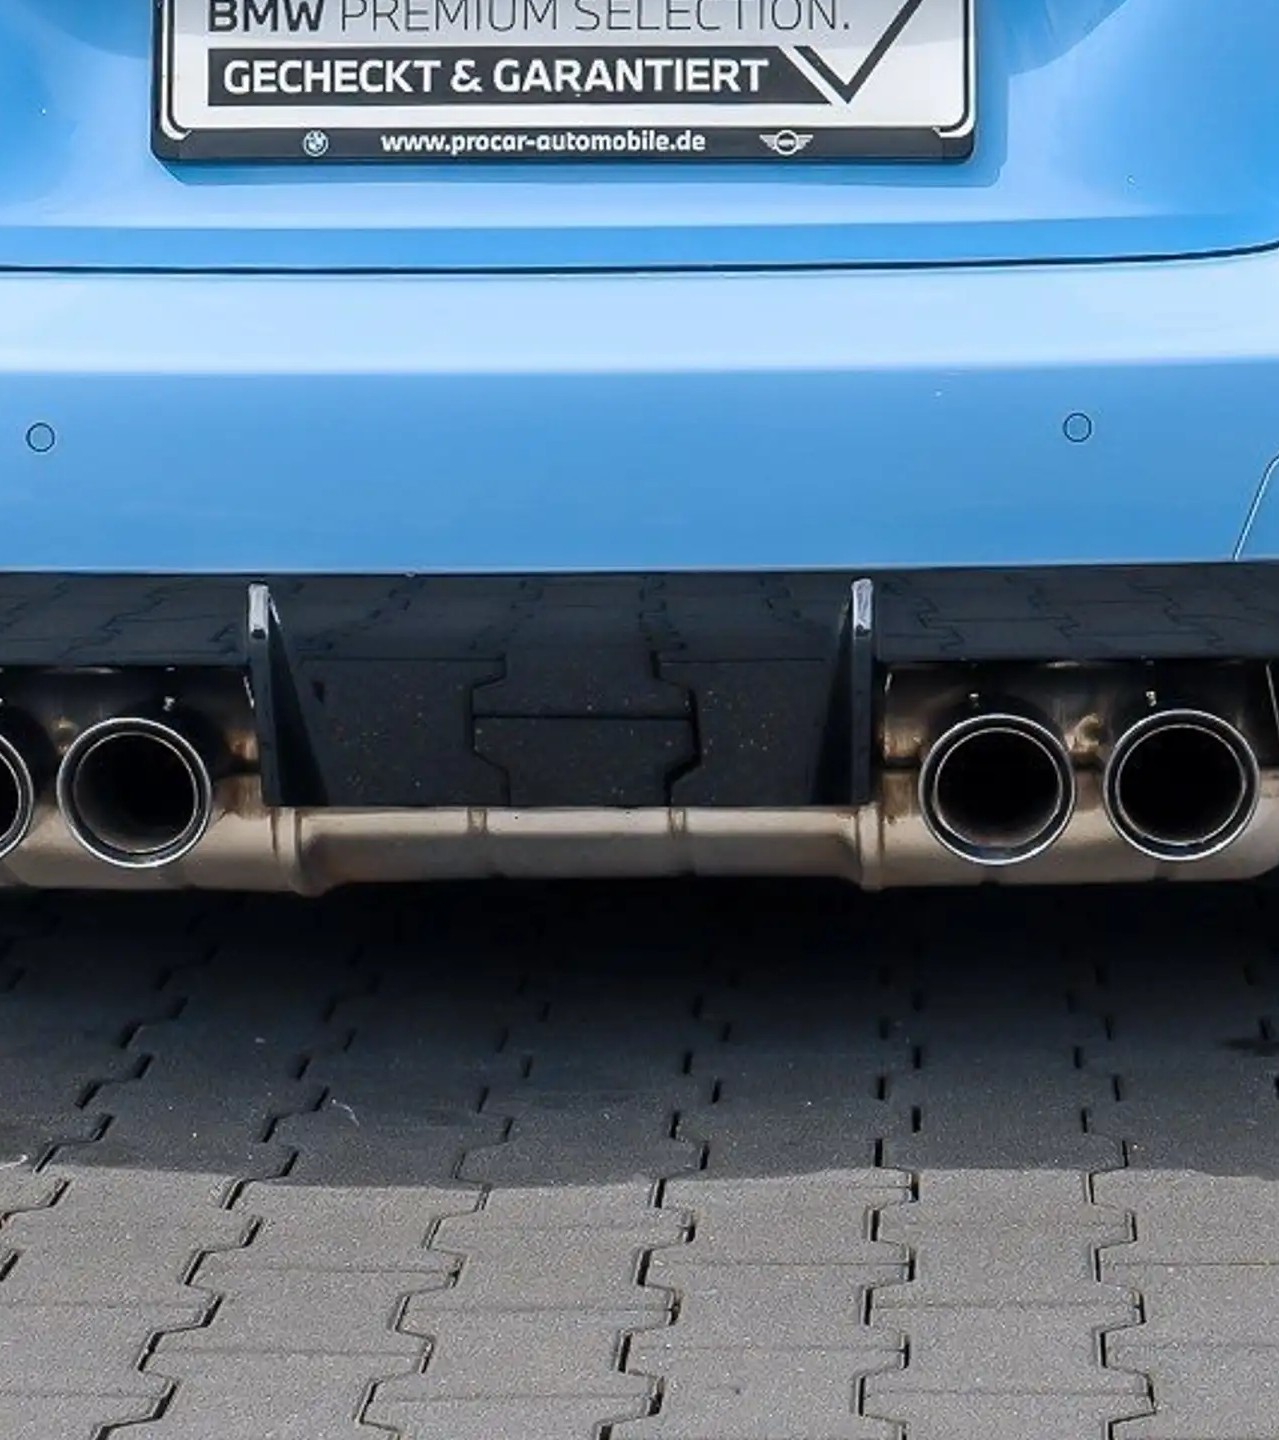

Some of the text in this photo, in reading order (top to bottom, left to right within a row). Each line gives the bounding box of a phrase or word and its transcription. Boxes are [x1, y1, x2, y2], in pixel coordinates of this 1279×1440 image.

[223, 58, 769, 93] GECHECKT & GARANTIERT
[381, 130, 706, 155] www.procar-automobile.de
